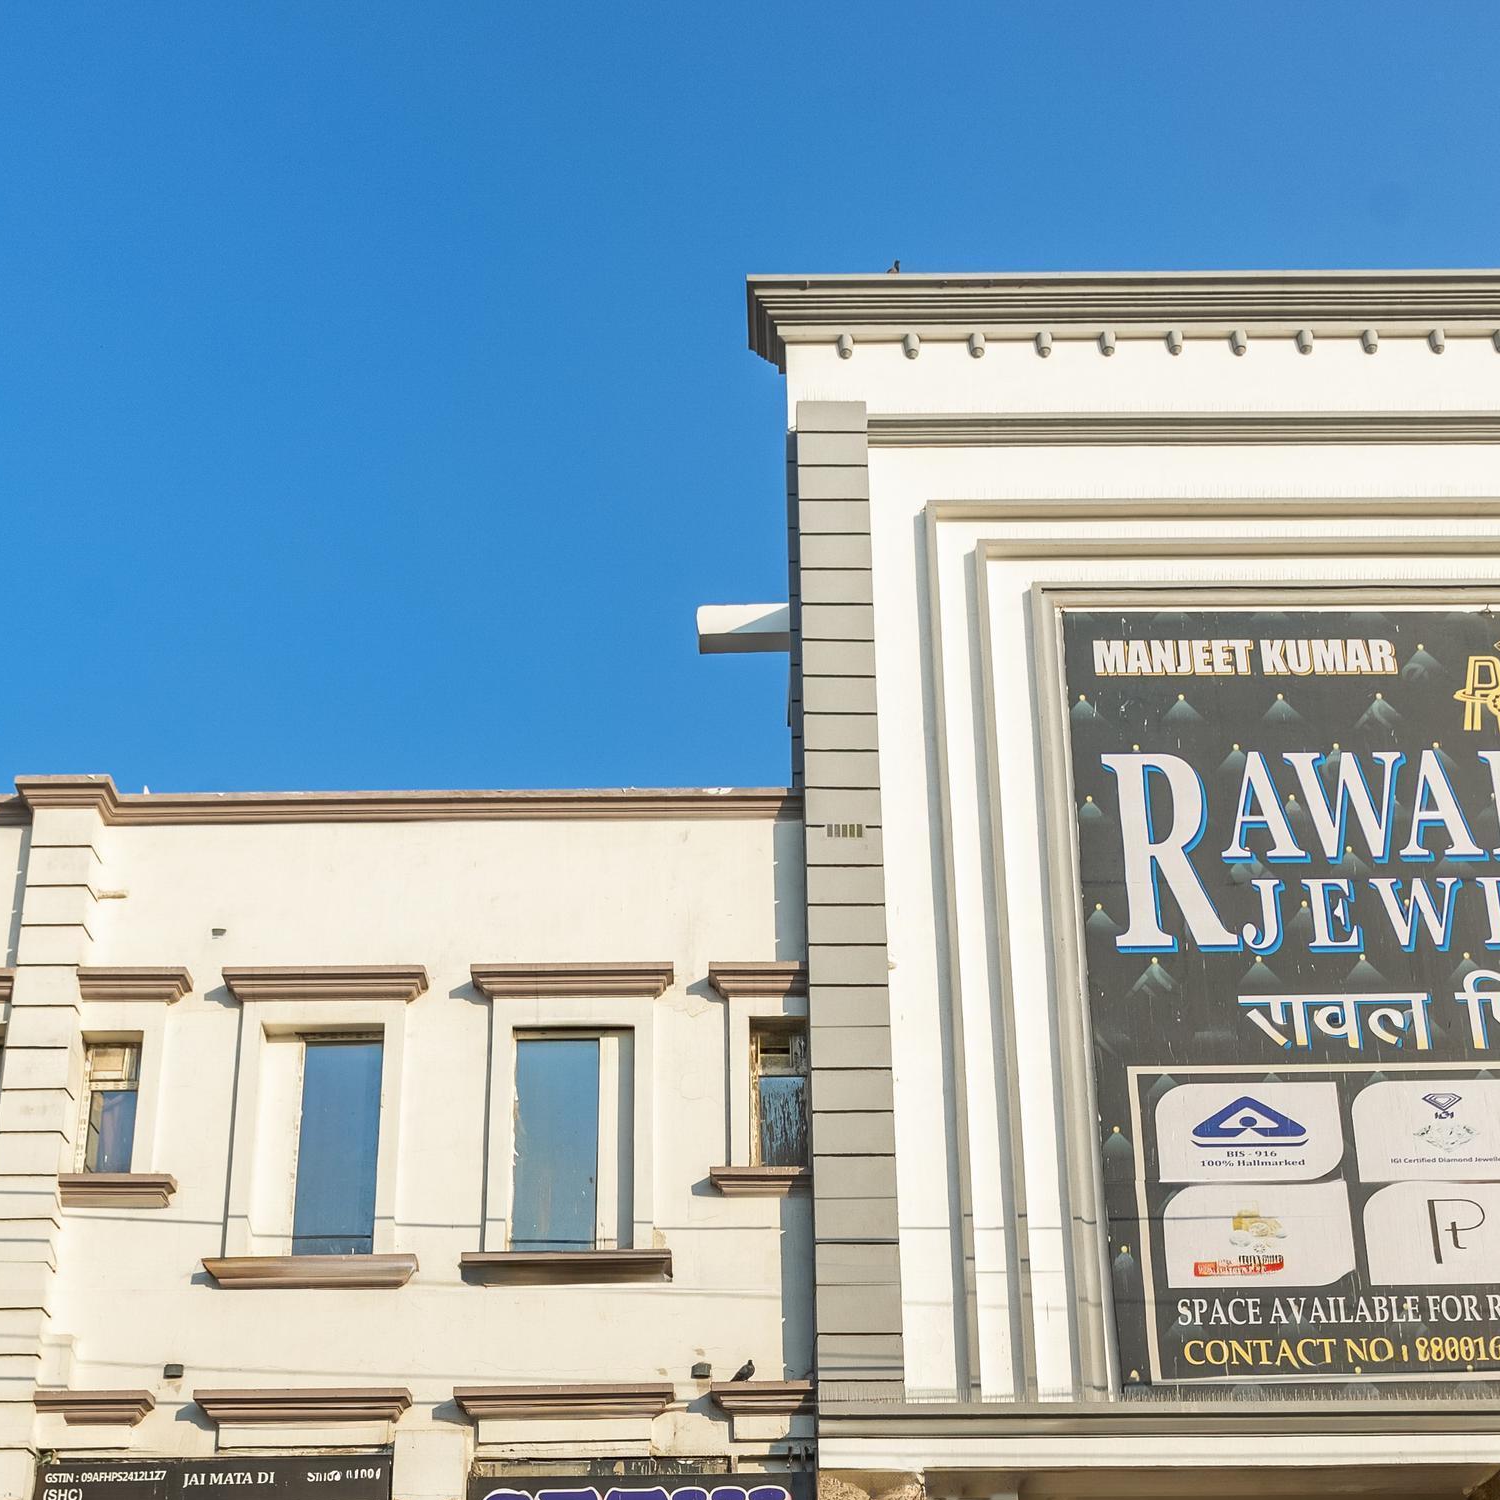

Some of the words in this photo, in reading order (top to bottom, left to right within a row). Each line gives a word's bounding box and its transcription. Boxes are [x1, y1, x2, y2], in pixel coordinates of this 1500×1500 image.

[1092, 639, 1253, 677] MANJEET
[1260, 637, 1398, 676] KUMAR
[1226, 1150, 1245, 1158] BIS
[1255, 1149, 1278, 1158] 916
[1200, 1159, 1235, 1168] 100%
[1237, 1157, 1306, 1168] Hallmarked
[1178, 1298, 1261, 1326] SPACE
[1270, 1295, 1426, 1325] AVAILABLE
[1429, 1295, 1486, 1322] FOR
[1183, 1338, 1337, 1369] CONTACT
[1346, 1337, 1395, 1362] NO
[45, 1472, 74, 1483] GSTIN
[183, 1473, 205, 1487] JAI
[210, 1473, 252, 1485] MATA
[257, 1472, 275, 1484] DI
